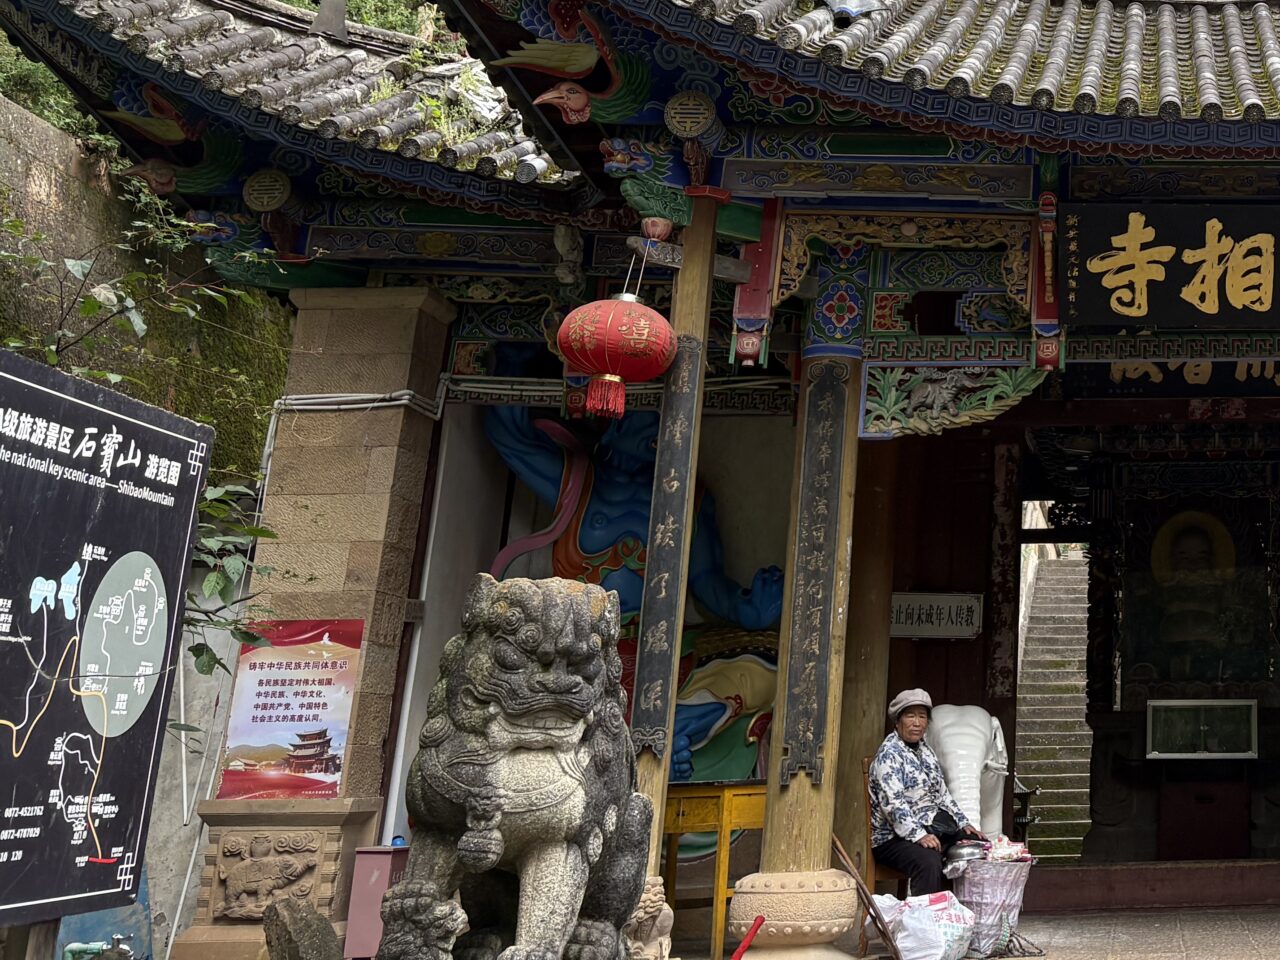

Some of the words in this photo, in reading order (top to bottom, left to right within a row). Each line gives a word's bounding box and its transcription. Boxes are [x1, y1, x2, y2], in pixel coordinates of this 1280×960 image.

[48, 458, 64, 480] key
[63, 468, 89, 484] scenic
[144, 453, 182, 487] 游览图
[248, 660, 349, 672] 铸牢中华民族共同体意识
[253, 701, 329, 711] 中国共产党、中国特色
